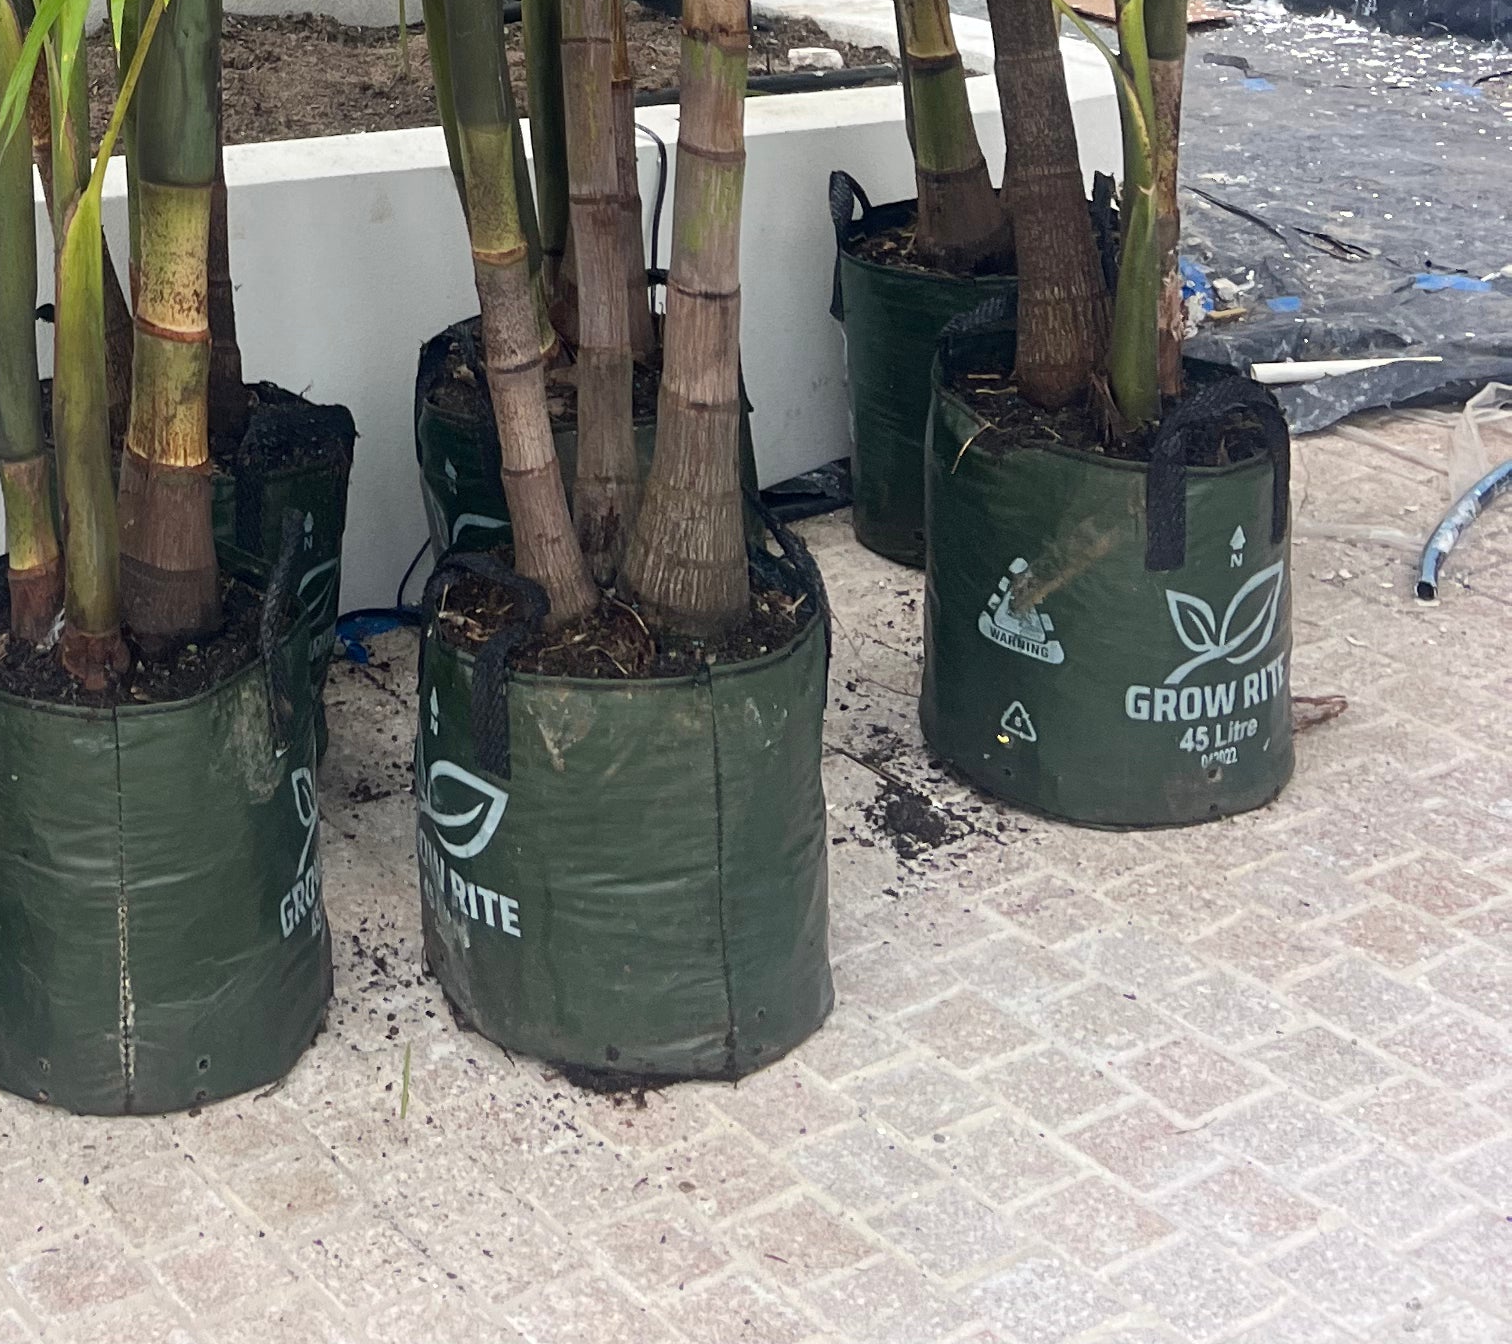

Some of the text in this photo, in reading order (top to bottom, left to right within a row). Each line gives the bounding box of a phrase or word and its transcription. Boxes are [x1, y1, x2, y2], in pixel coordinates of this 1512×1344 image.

[1230, 552, 1243, 568] N
[990, 627, 1050, 659] WARNING
[1125, 681, 1237, 722] GROW
[1179, 718, 1259, 752] 45 Litre
[450, 868, 522, 938] RITE
